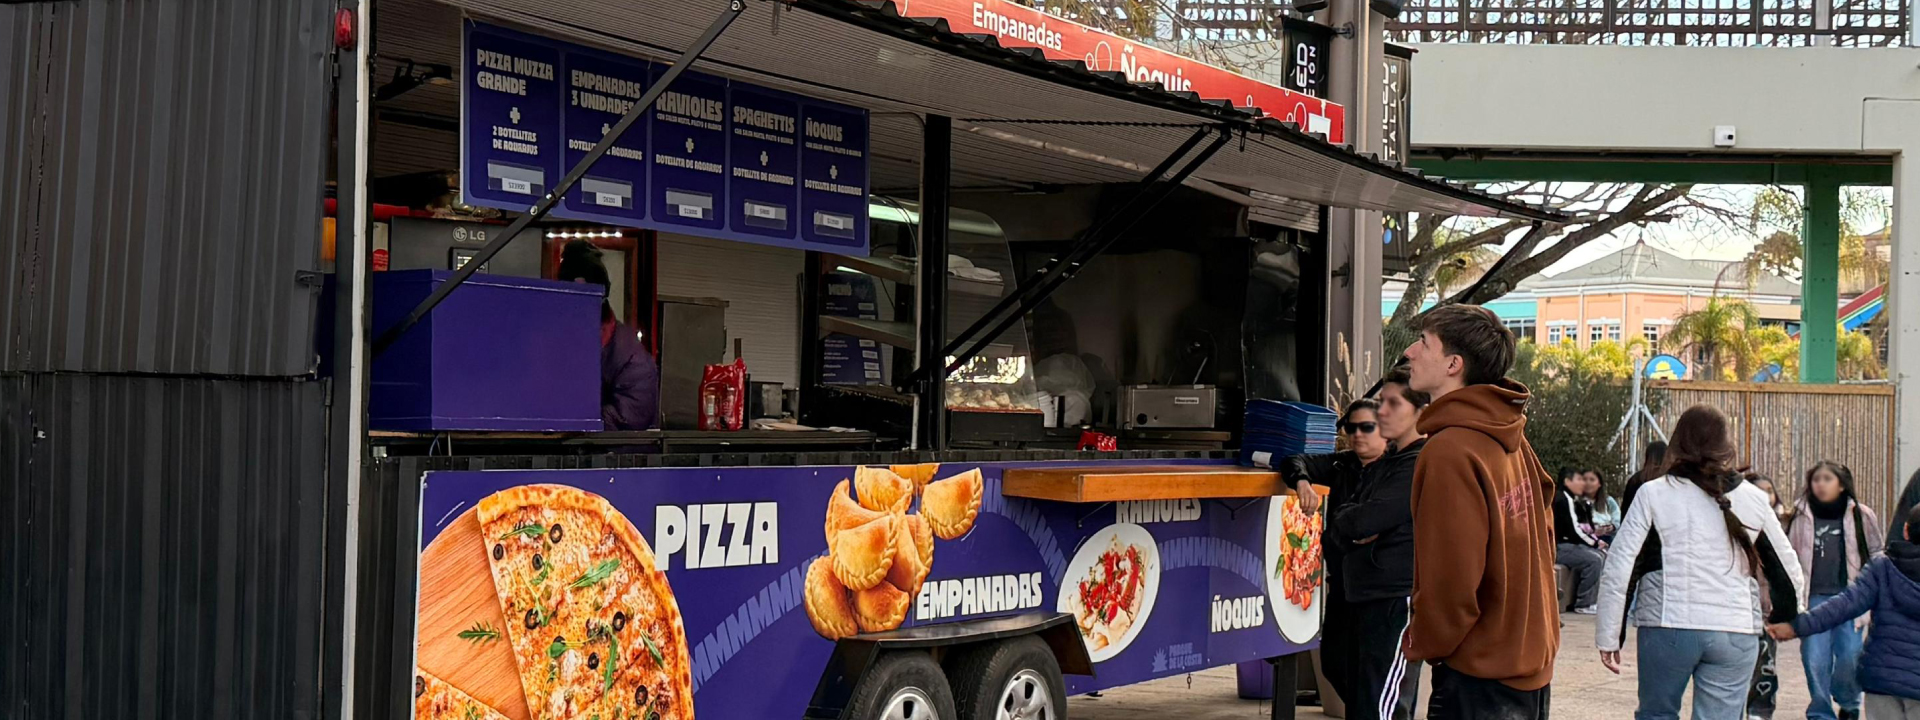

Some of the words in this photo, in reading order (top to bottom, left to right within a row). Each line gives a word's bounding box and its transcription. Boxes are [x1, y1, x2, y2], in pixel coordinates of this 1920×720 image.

[972, 1, 1063, 51] Empanadas
[476, 48, 512, 72] PIZZA
[514, 57, 554, 81] MUZZA
[477, 71, 527, 96] GRANDE
[571, 69, 641, 99] EMPANADAS
[571, 90, 579, 106] 3
[733, 105, 795, 134] SPAGHETTIS
[1389, 64, 1398, 158] TALLAS
[492, 125, 498, 136] 2
[492, 138, 503, 150] DE
[805, 117, 843, 142] ÑOQUIS
[469, 231, 486, 241] LG
[655, 502, 779, 571] PIZZA
[916, 571, 1043, 620] EMPANADAS
[1211, 594, 1265, 633] ÑOQUIS
